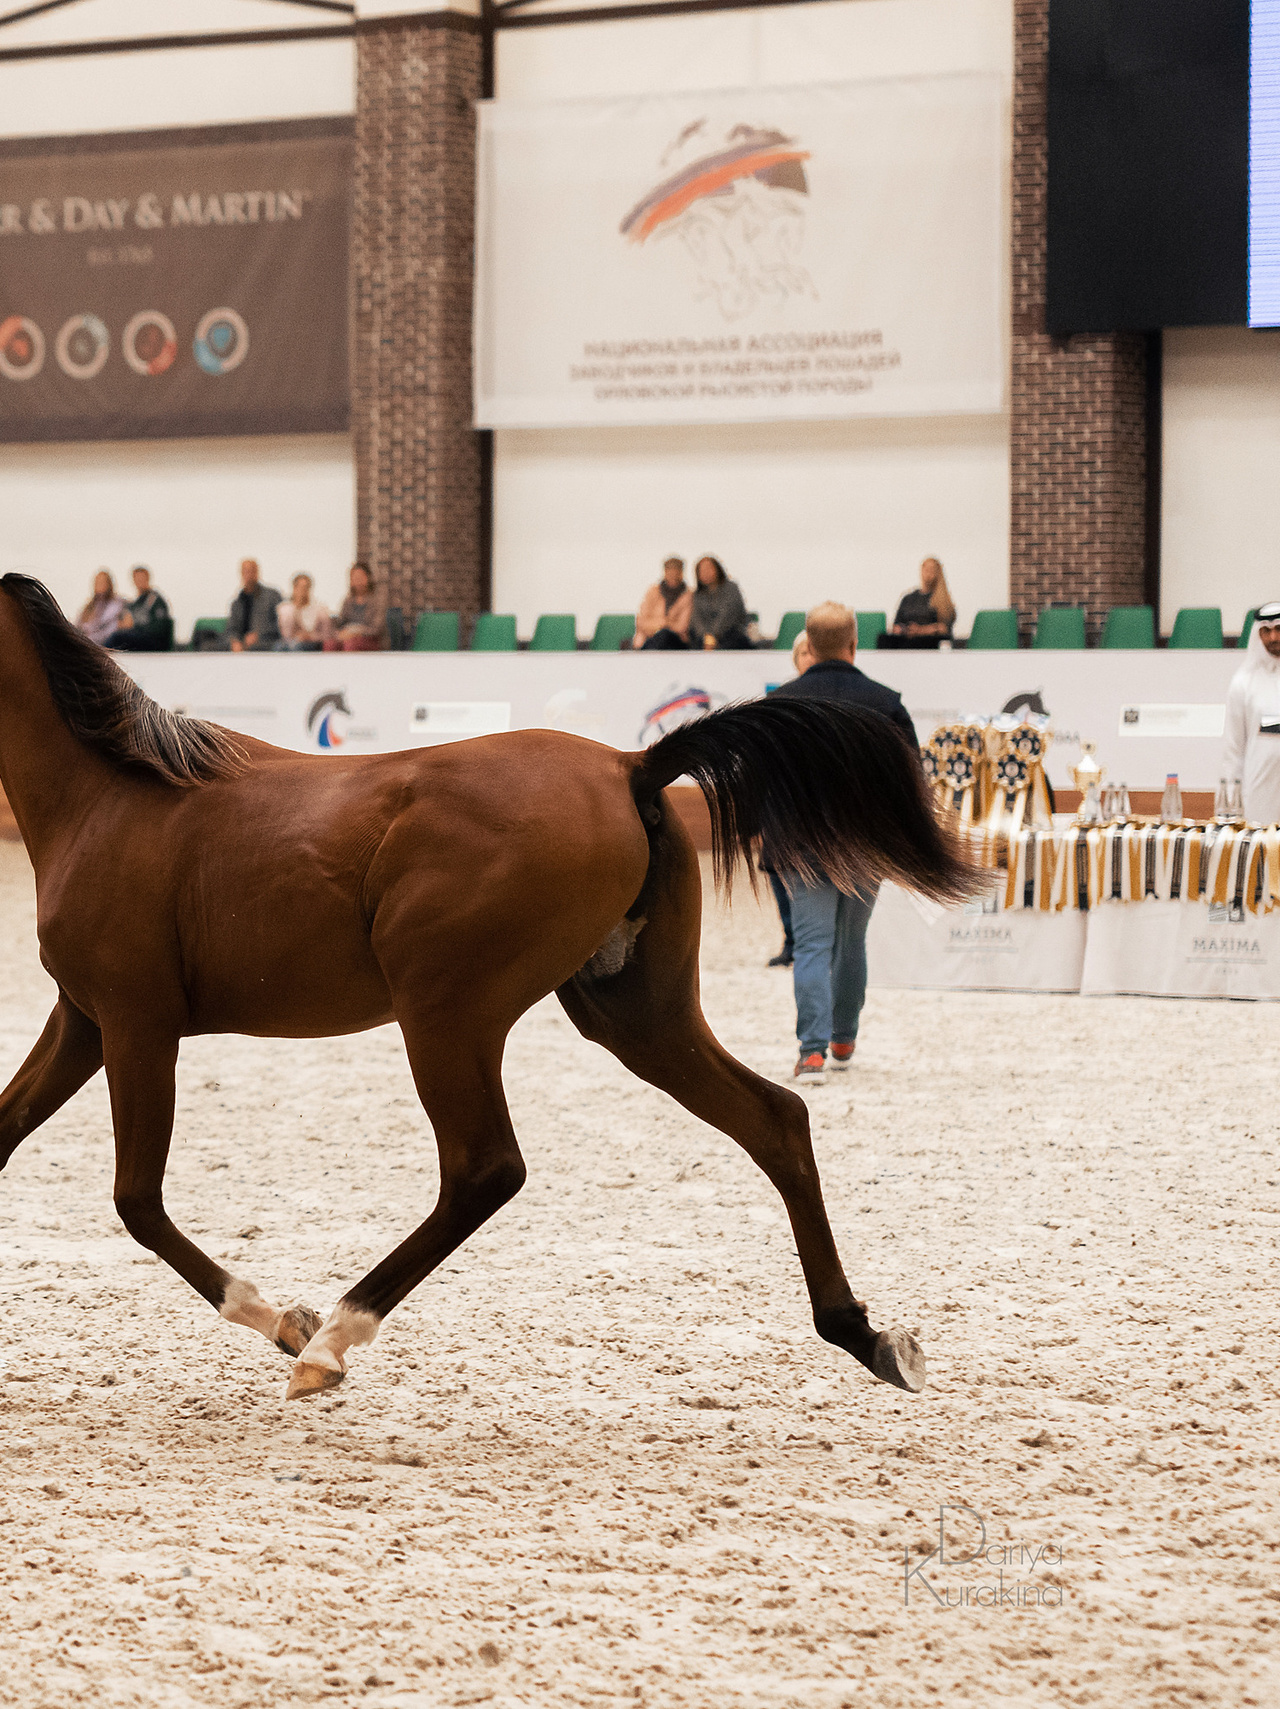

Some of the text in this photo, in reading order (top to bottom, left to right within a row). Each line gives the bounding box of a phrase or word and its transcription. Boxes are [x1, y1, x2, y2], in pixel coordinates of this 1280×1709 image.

[28, 198, 57, 234] &
[134, 192, 163, 229] &
[583, 328, 883, 358] НАЦИОНАЛЬНАЯ АССОЦИАЦИЯ
[949, 926, 1013, 943] MAXIMA
[1192, 936, 1262, 954] MAXIMA
